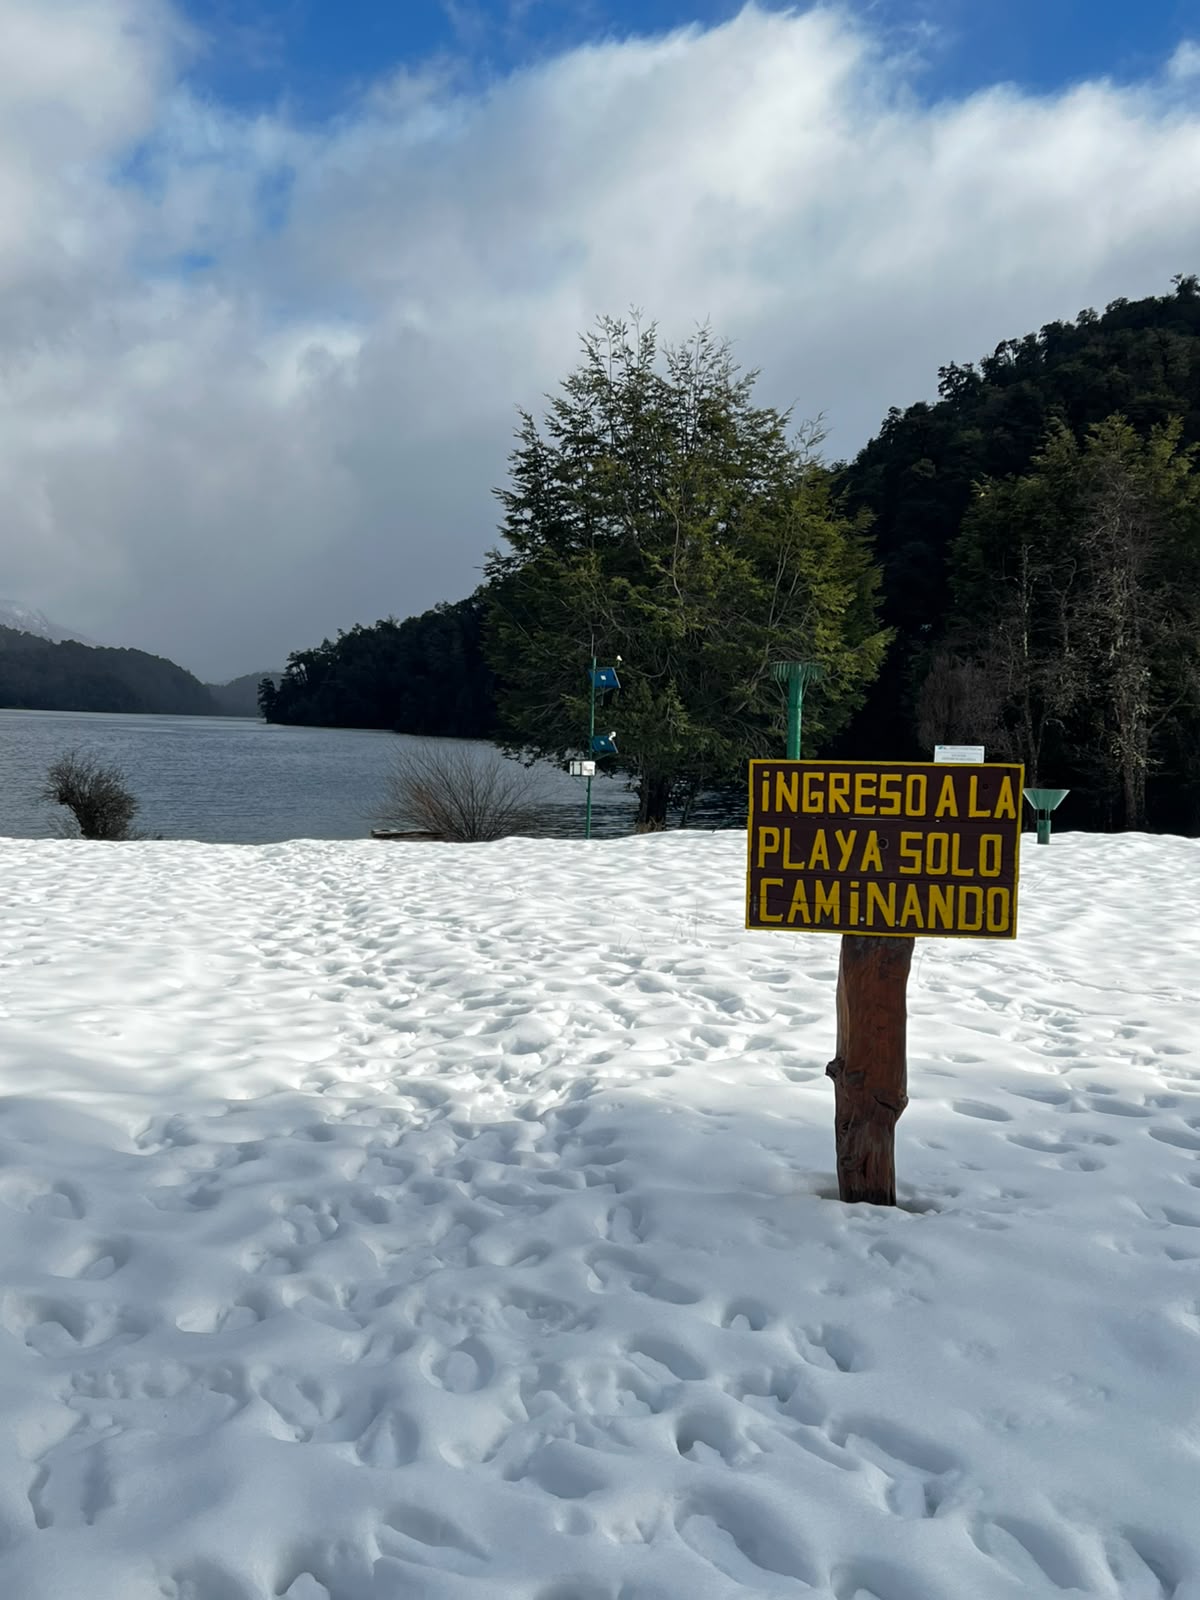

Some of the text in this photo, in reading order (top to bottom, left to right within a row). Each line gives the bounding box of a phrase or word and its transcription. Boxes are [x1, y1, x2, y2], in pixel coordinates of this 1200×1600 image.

[934, 775, 959, 818] A
[968, 775, 1017, 819] LA
[757, 826, 1003, 878] PLAYA SOLO
